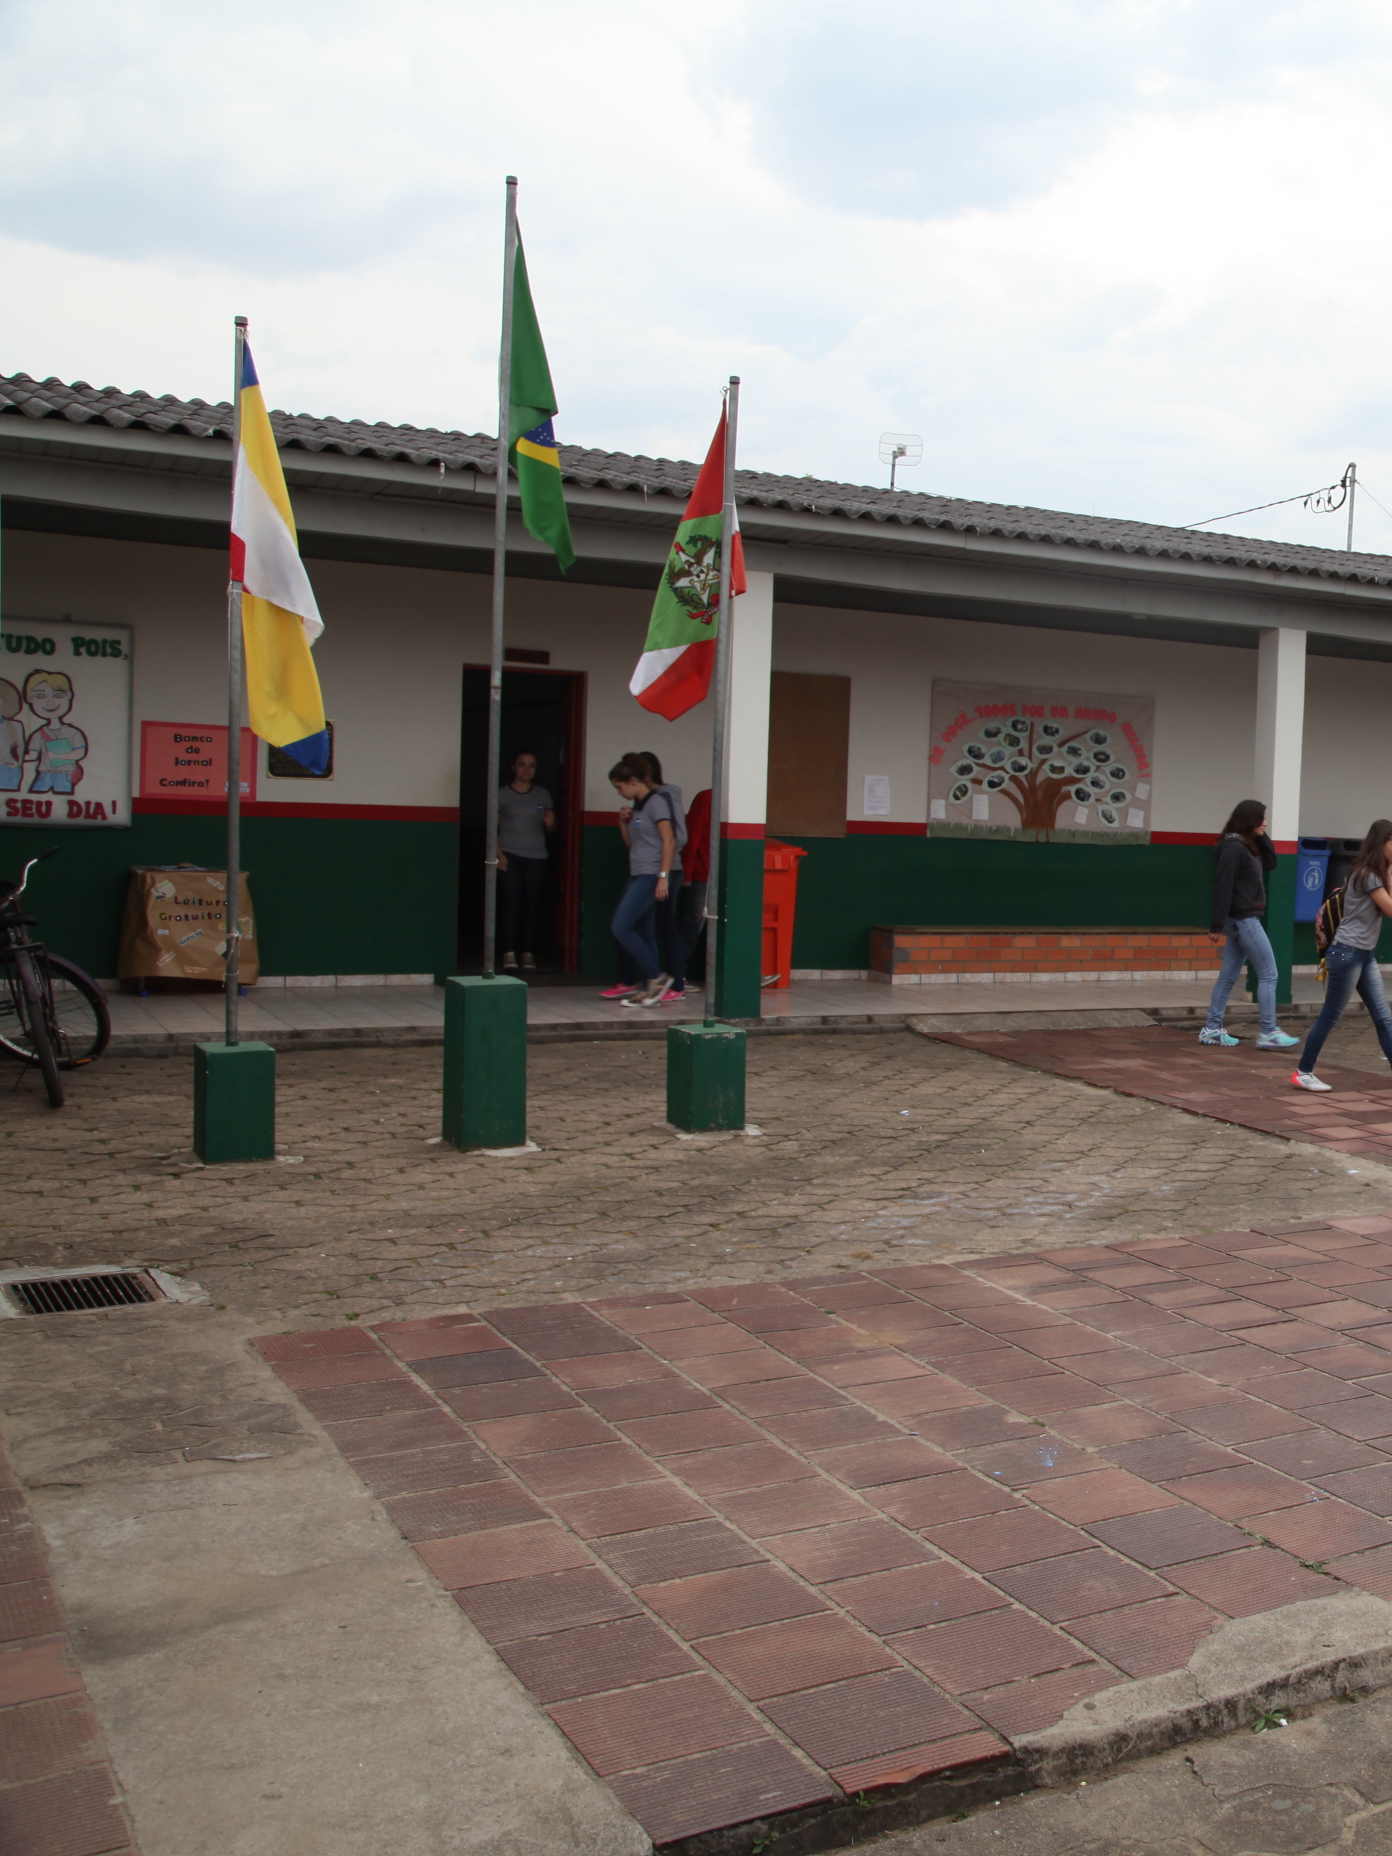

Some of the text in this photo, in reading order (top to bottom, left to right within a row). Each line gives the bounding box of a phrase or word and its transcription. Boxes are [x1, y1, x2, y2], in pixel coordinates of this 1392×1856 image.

[0, 633, 129, 660] UDO POIS,
[1021, 704, 1045, 718] POR
[1050, 705, 1069, 719] UM
[1074, 706, 1117, 724] MUNDO
[173, 733, 213, 743] Banca
[185, 744, 201, 754] de
[174, 756, 213, 767] Jornal
[159, 777, 210, 788] Confira!
[5, 797, 53, 819] SEU
[159, 911, 222, 922] Gratuita
